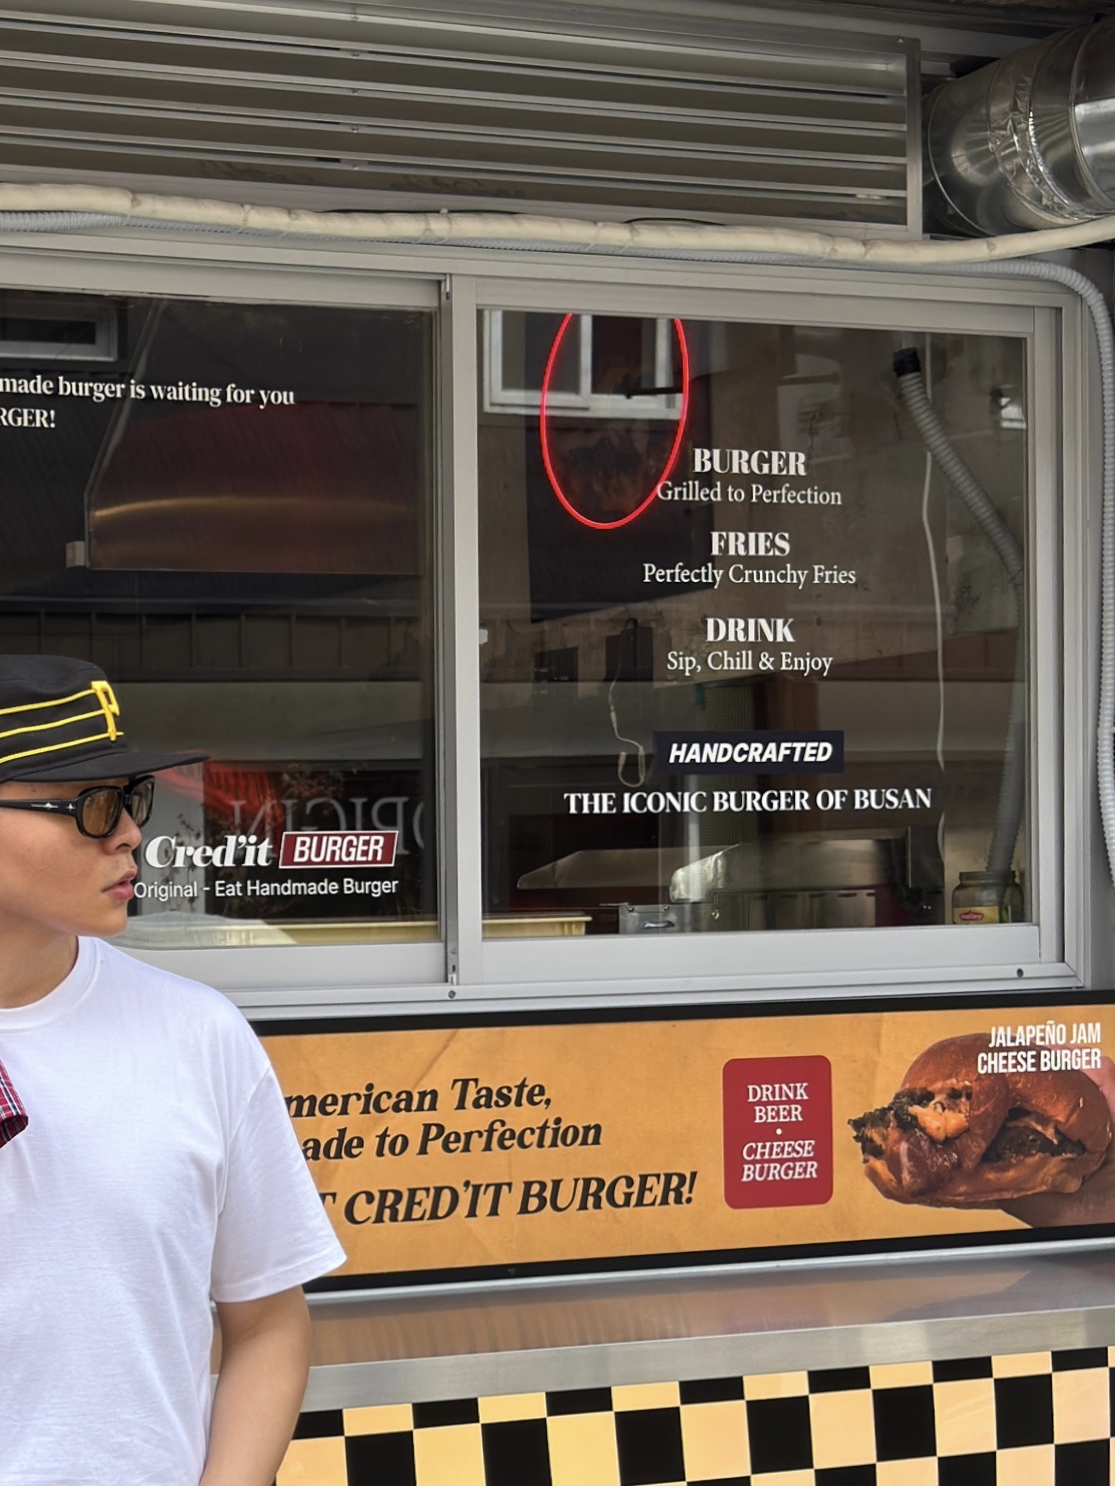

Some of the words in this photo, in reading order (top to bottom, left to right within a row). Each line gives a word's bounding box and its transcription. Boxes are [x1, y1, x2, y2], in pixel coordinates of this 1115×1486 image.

[58, 375, 126, 402] burger
[129, 379, 146, 399] is
[149, 381, 222, 407] waiting
[226, 383, 255, 403] for
[259, 389, 295, 410] you
[694, 448, 807, 476] BURGER
[655, 480, 722, 502] Grilled
[727, 485, 745, 502] to
[751, 483, 842, 505] Perfection
[711, 531, 791, 557] FRIES
[643, 562, 724, 590] Perfectly
[728, 563, 809, 590] Crunchy
[812, 564, 856, 584] Fries
[706, 617, 795, 643] DRINK
[667, 650, 702, 677] Sip,
[707, 649, 754, 671] Chill
[758, 651, 775, 671] &
[780, 651, 834, 677] Enjoy
[668, 741, 833, 764] HANDCRAFTED
[563, 792, 617, 814] THE
[622, 791, 707, 814] ICONIC
[712, 790, 811, 812] BURGER
[816, 789, 848, 811] OF
[854, 788, 931, 810] BUSAN
[145, 834, 273, 869] Cred'it
[293, 835, 385, 863] BURGER
[133, 880, 198, 902] Original
[215, 880, 243, 897] Eat
[246, 878, 339, 896] Handmade
[343, 877, 399, 898] Burger
[988, 1019, 1067, 1048] JALAPEÑO
[1069, 1022, 1101, 1045] JAM
[977, 1050, 1037, 1075] CHEESE
[1040, 1047, 1104, 1072] BURGER
[284, 1082, 439, 1118] merican
[450, 1077, 552, 1111] Taste,
[747, 1082, 809, 1102] DRINK
[754, 1104, 803, 1123] BEER
[301, 1126, 365, 1162] ade
[375, 1126, 410, 1158] to
[416, 1116, 602, 1156] Perfection
[742, 1139, 815, 1161] CHEESE
[741, 1160, 818, 1182] BURGER
[344, 1179, 513, 1225] CRED'IT
[516, 1170, 698, 1215] BURGER!
